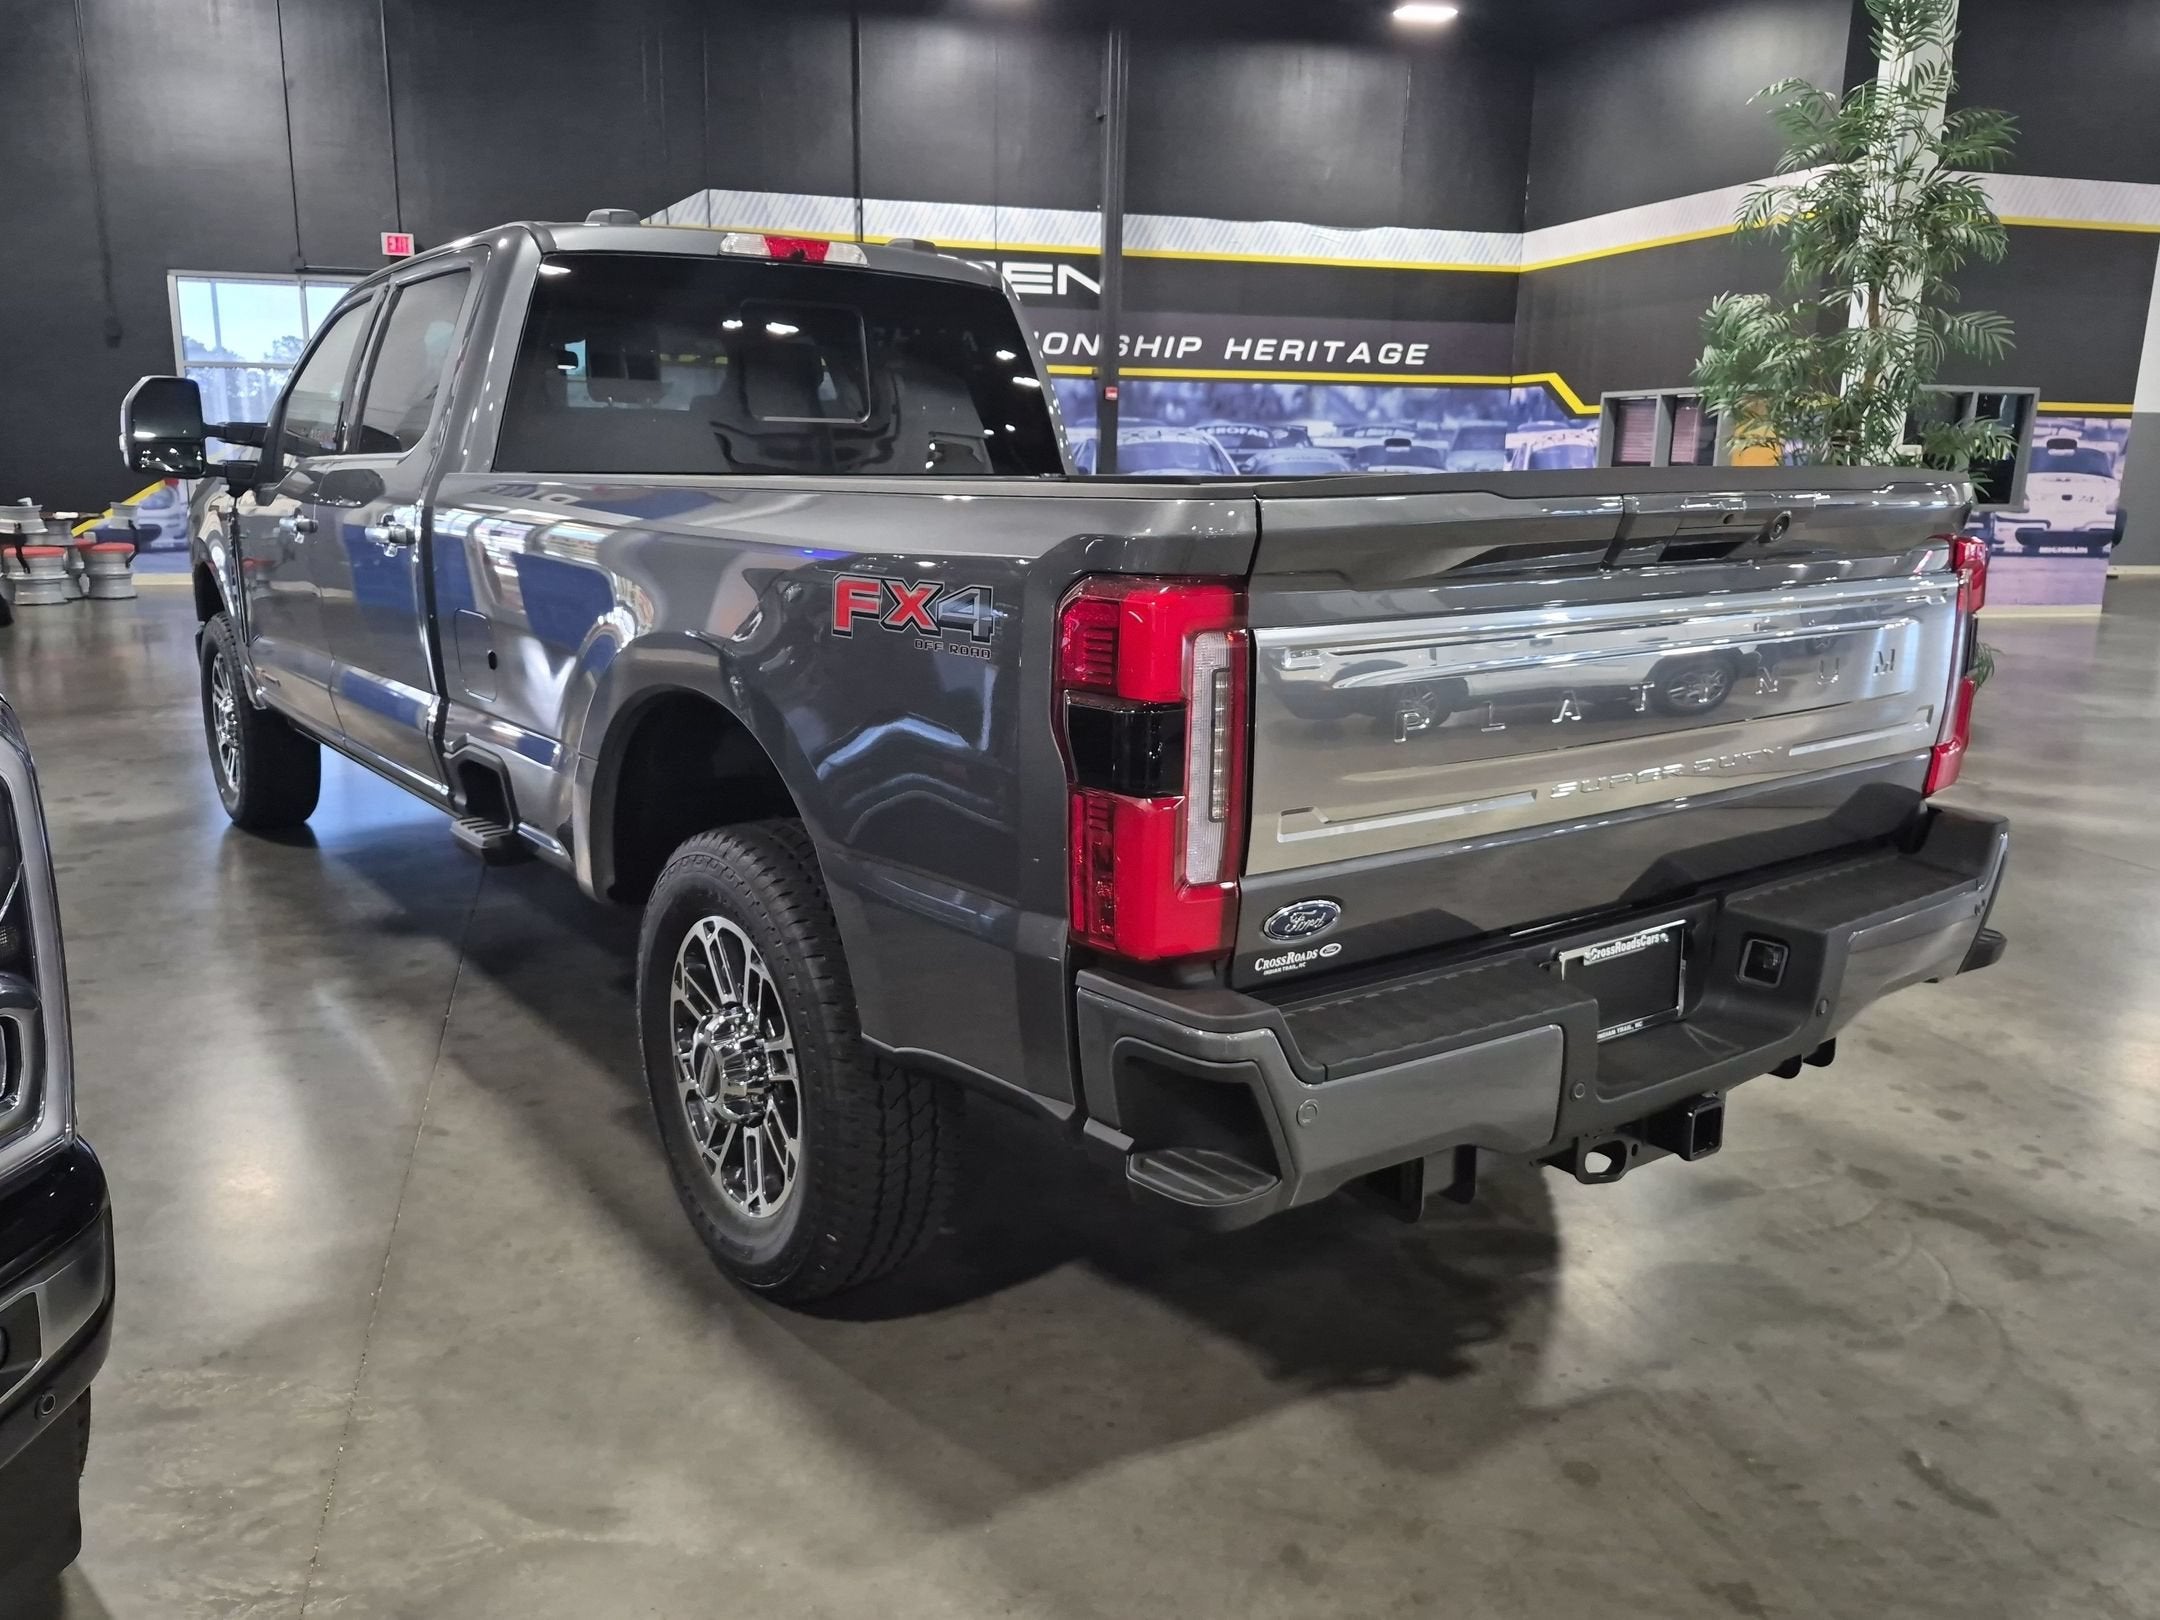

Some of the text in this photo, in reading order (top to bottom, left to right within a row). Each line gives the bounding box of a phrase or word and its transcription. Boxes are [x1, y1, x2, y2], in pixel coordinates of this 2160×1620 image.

[1034, 331, 1430, 366] ONSHIP HERITAGE
[832, 572, 994, 645] FX4
[914, 638, 993, 660] OFF ROAD
[1394, 648, 1896, 743] PLATINUM
[1550, 763, 1685, 799] SUPER
